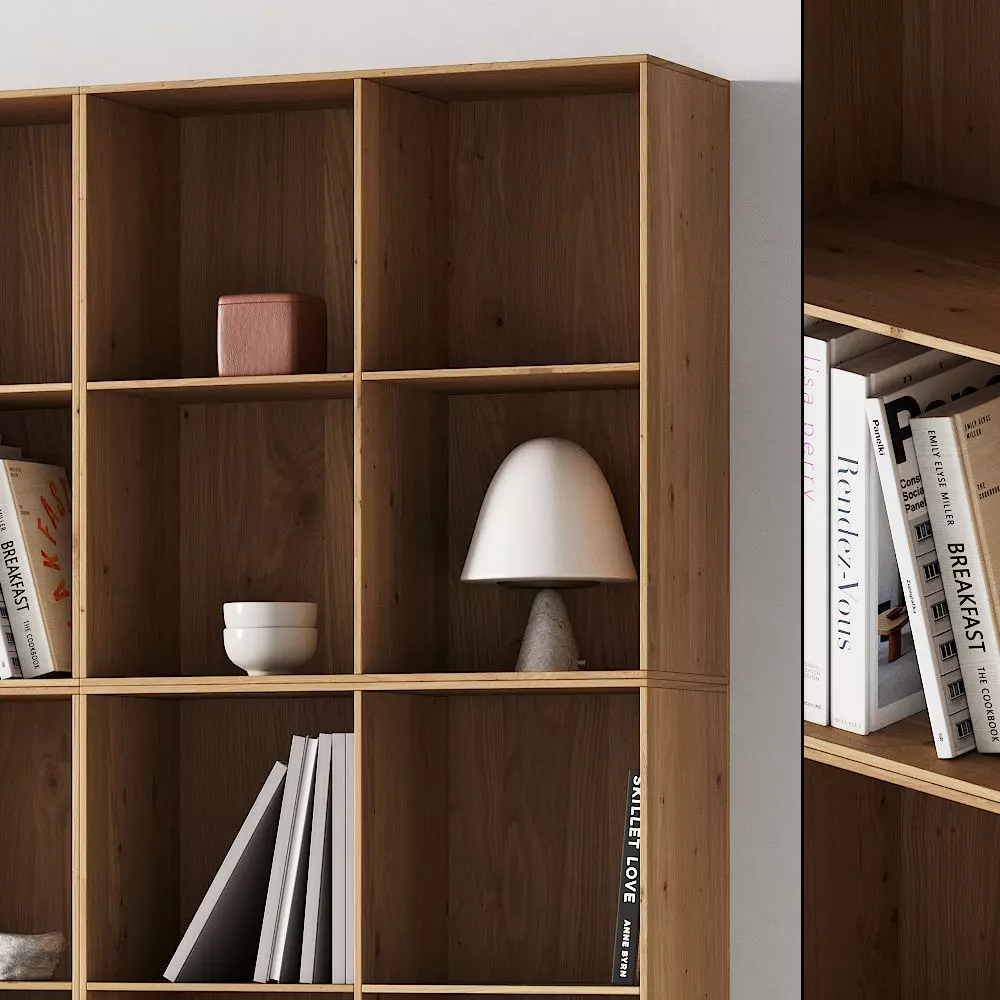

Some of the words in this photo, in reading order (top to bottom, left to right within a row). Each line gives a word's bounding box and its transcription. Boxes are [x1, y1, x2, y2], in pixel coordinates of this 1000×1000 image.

[872, 418, 885, 456] Panelki
[927, 430, 941, 458] EMILY
[934, 461, 947, 488] ELYSE
[940, 491, 955, 526] MILLER
[837, 455, 859, 650] Rendez-Vous
[0, 540, 30, 611] BREAKFAST
[947, 542, 986, 653] BREAKFAST
[23, 620, 31, 632] THE
[26, 633, 40, 669] COOKBOOK
[977, 666, 988, 684] THE
[979, 687, 1000, 743] COOKBOOK
[627, 775, 640, 849] SKILLET
[623, 856, 638, 903] LOVE
[621, 919, 632, 948] ANNE
[619, 949, 629, 978] BYRN
